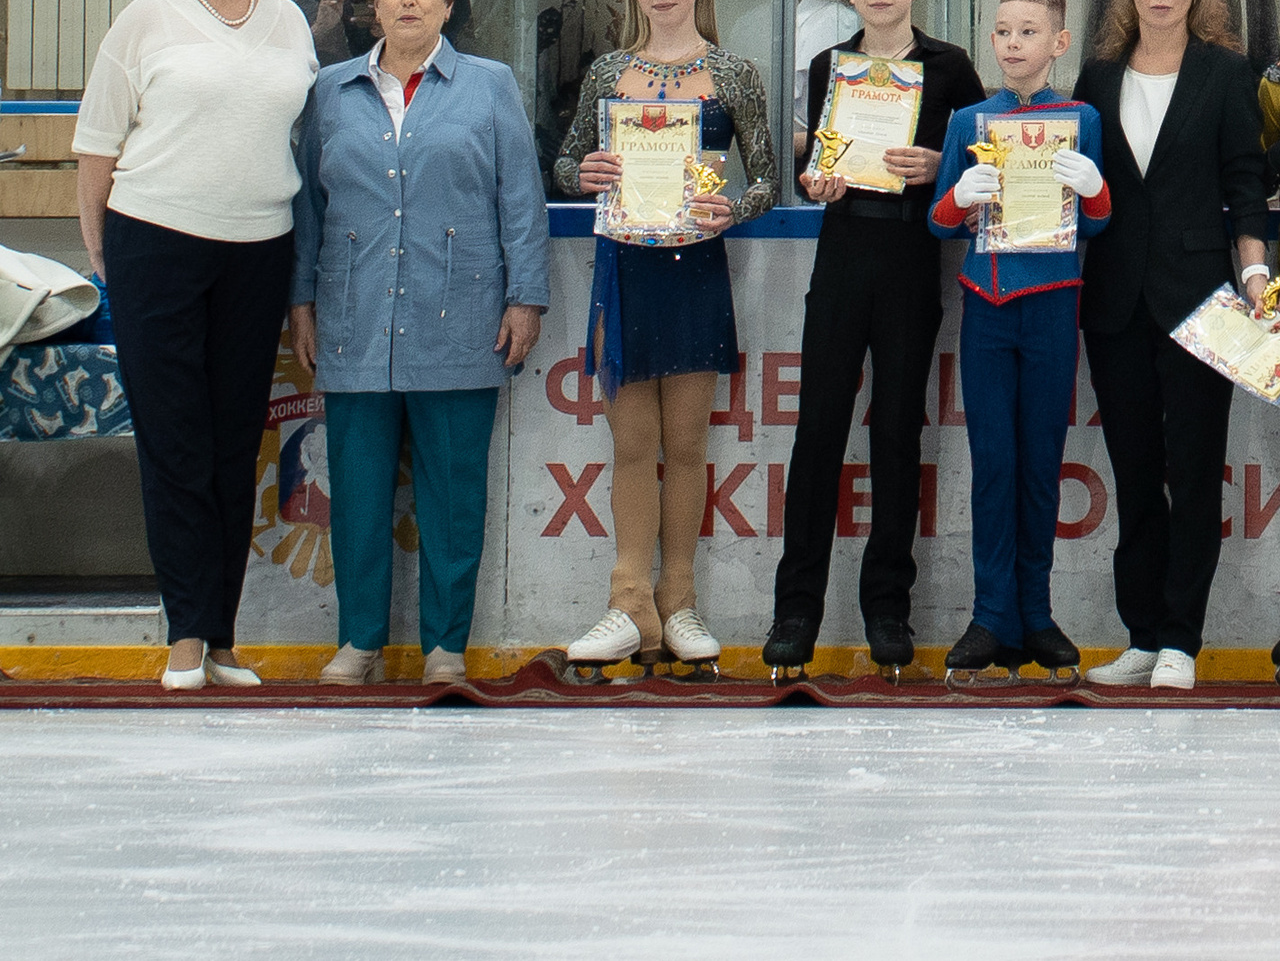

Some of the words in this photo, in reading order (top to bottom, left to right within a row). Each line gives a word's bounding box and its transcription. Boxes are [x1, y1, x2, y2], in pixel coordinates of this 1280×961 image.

[851, 89, 903, 103] ГРАМОТА
[620, 141, 686, 153] ГРАМОТА
[1002, 159, 1054, 170] ГРАМОТ
[268, 394, 325, 421] ХОККЕЙ
